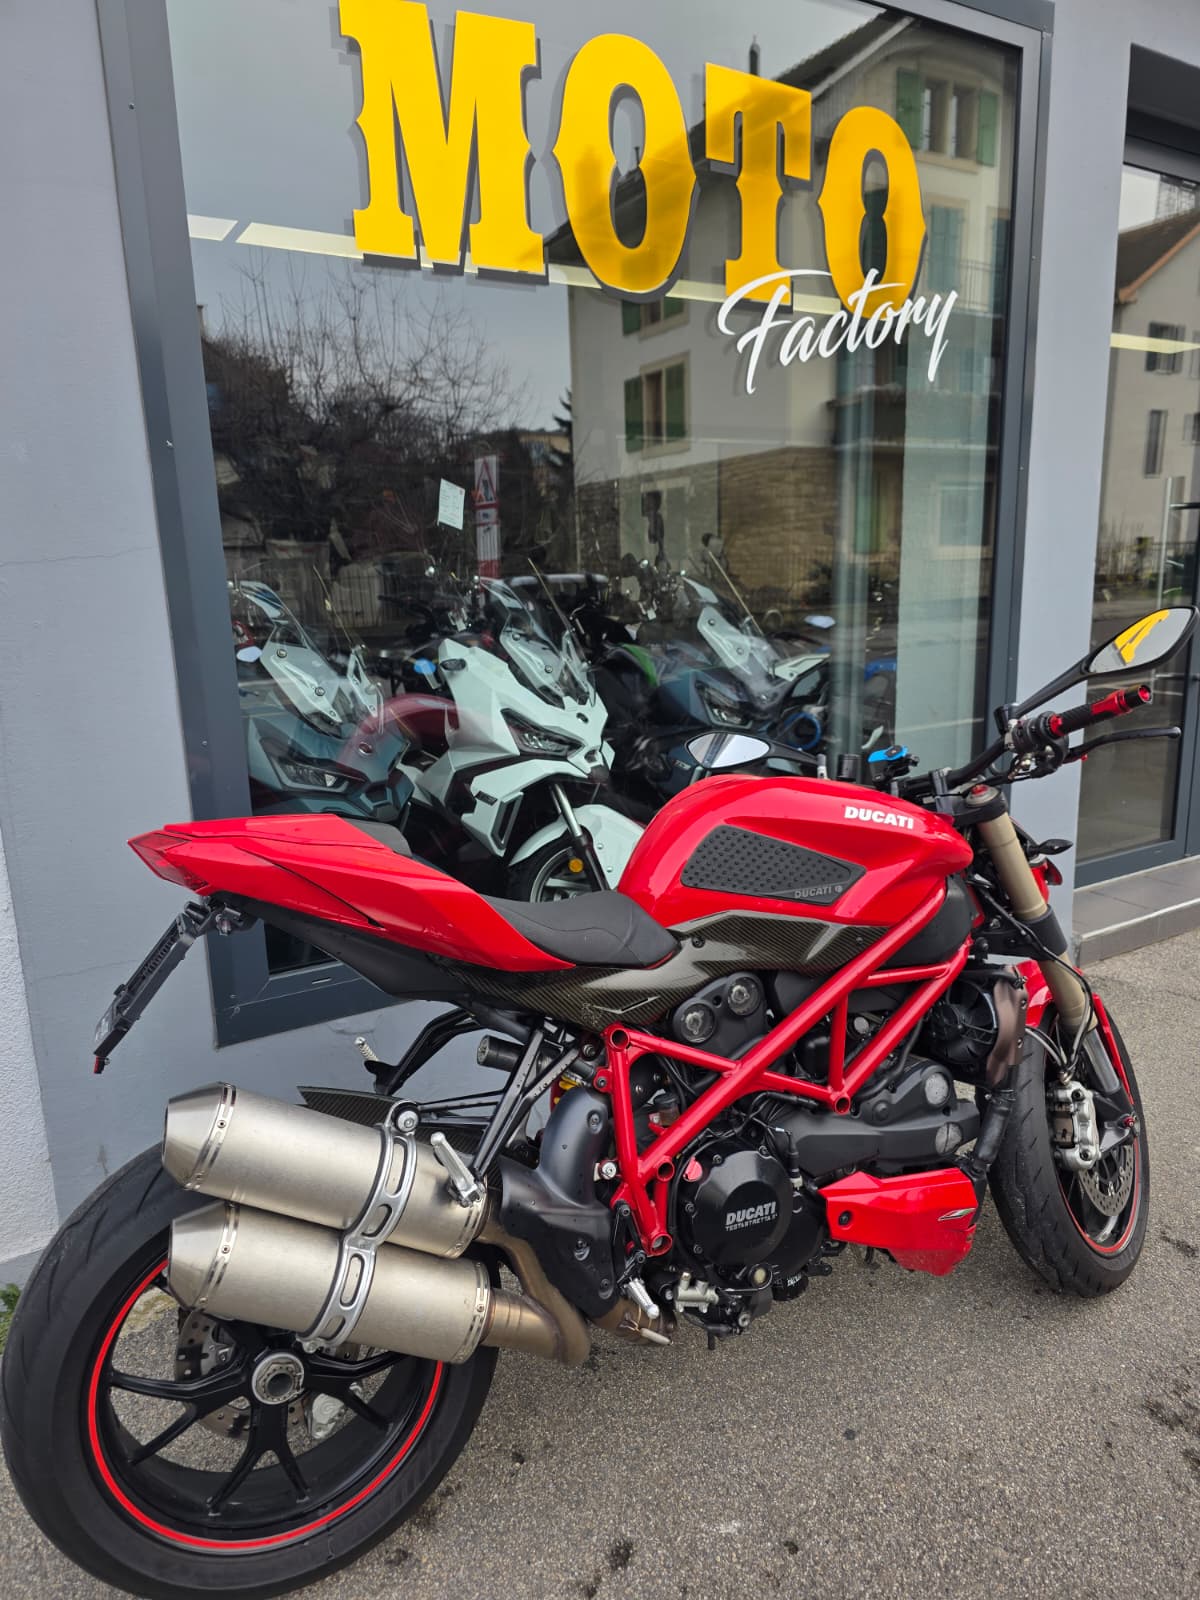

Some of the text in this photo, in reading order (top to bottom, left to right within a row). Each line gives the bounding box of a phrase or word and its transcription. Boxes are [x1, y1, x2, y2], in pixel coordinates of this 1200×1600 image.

[339, 0, 926, 320] MOTO
[717, 267, 958, 395] Factory
[844, 806, 914, 829] DUCATI
[794, 885, 832, 898] DUCATI
[726, 1201, 776, 1225] DUCATI
